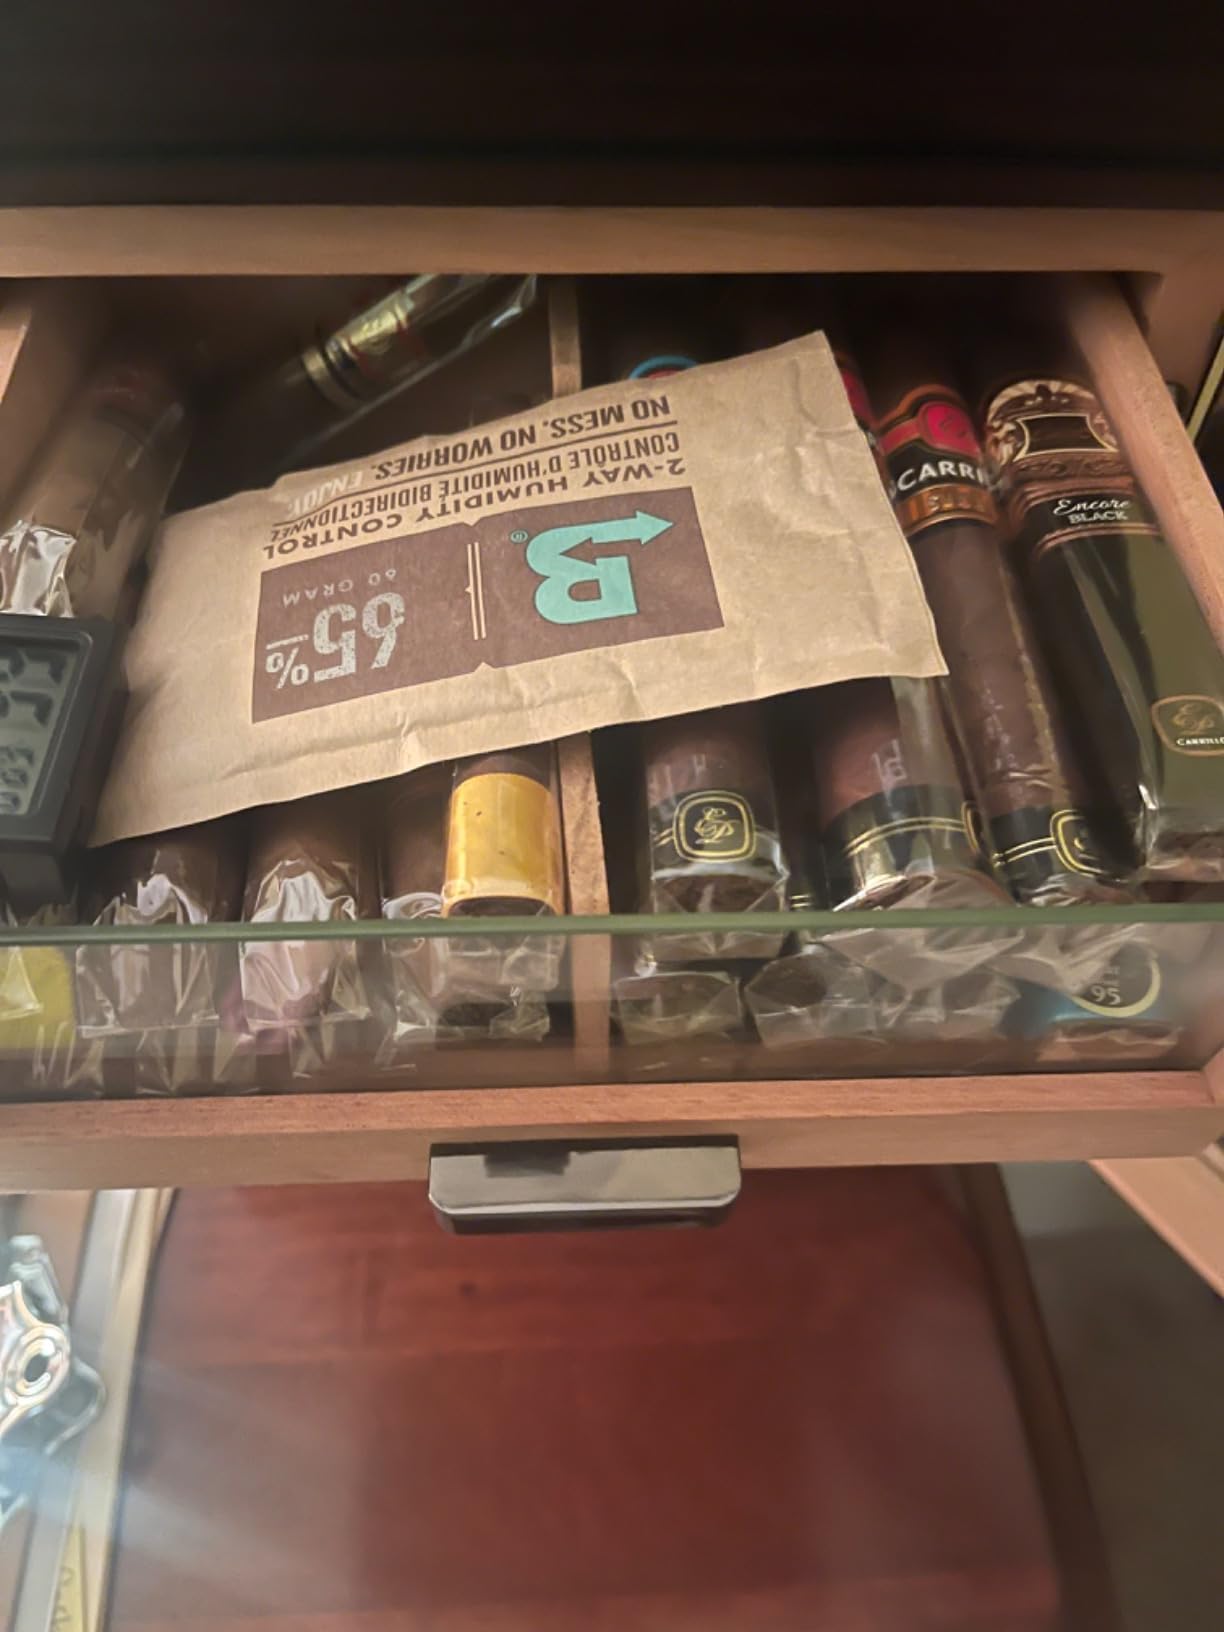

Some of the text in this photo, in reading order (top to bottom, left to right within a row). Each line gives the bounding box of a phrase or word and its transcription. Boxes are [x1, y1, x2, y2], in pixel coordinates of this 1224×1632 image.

[543, 404, 626, 439] MESS.
[631, 394, 671, 420] NO
[500, 423, 537, 452] NO
[570, 431, 681, 473] CONTRÔLE
[374, 433, 495, 481] WORRIES.
[262, 456, 687, 560] 2-WAY HUMIDITY CONTROL
[270, 480, 433, 543] BIDIRECTIONNEL
[1053, 499, 1131, 516] Encore
[1068, 511, 1129, 524] BLACK
[282, 567, 397, 609] 60 GRAM
[264, 592, 406, 689] 65%
[1090, 985, 1121, 1005] 95
